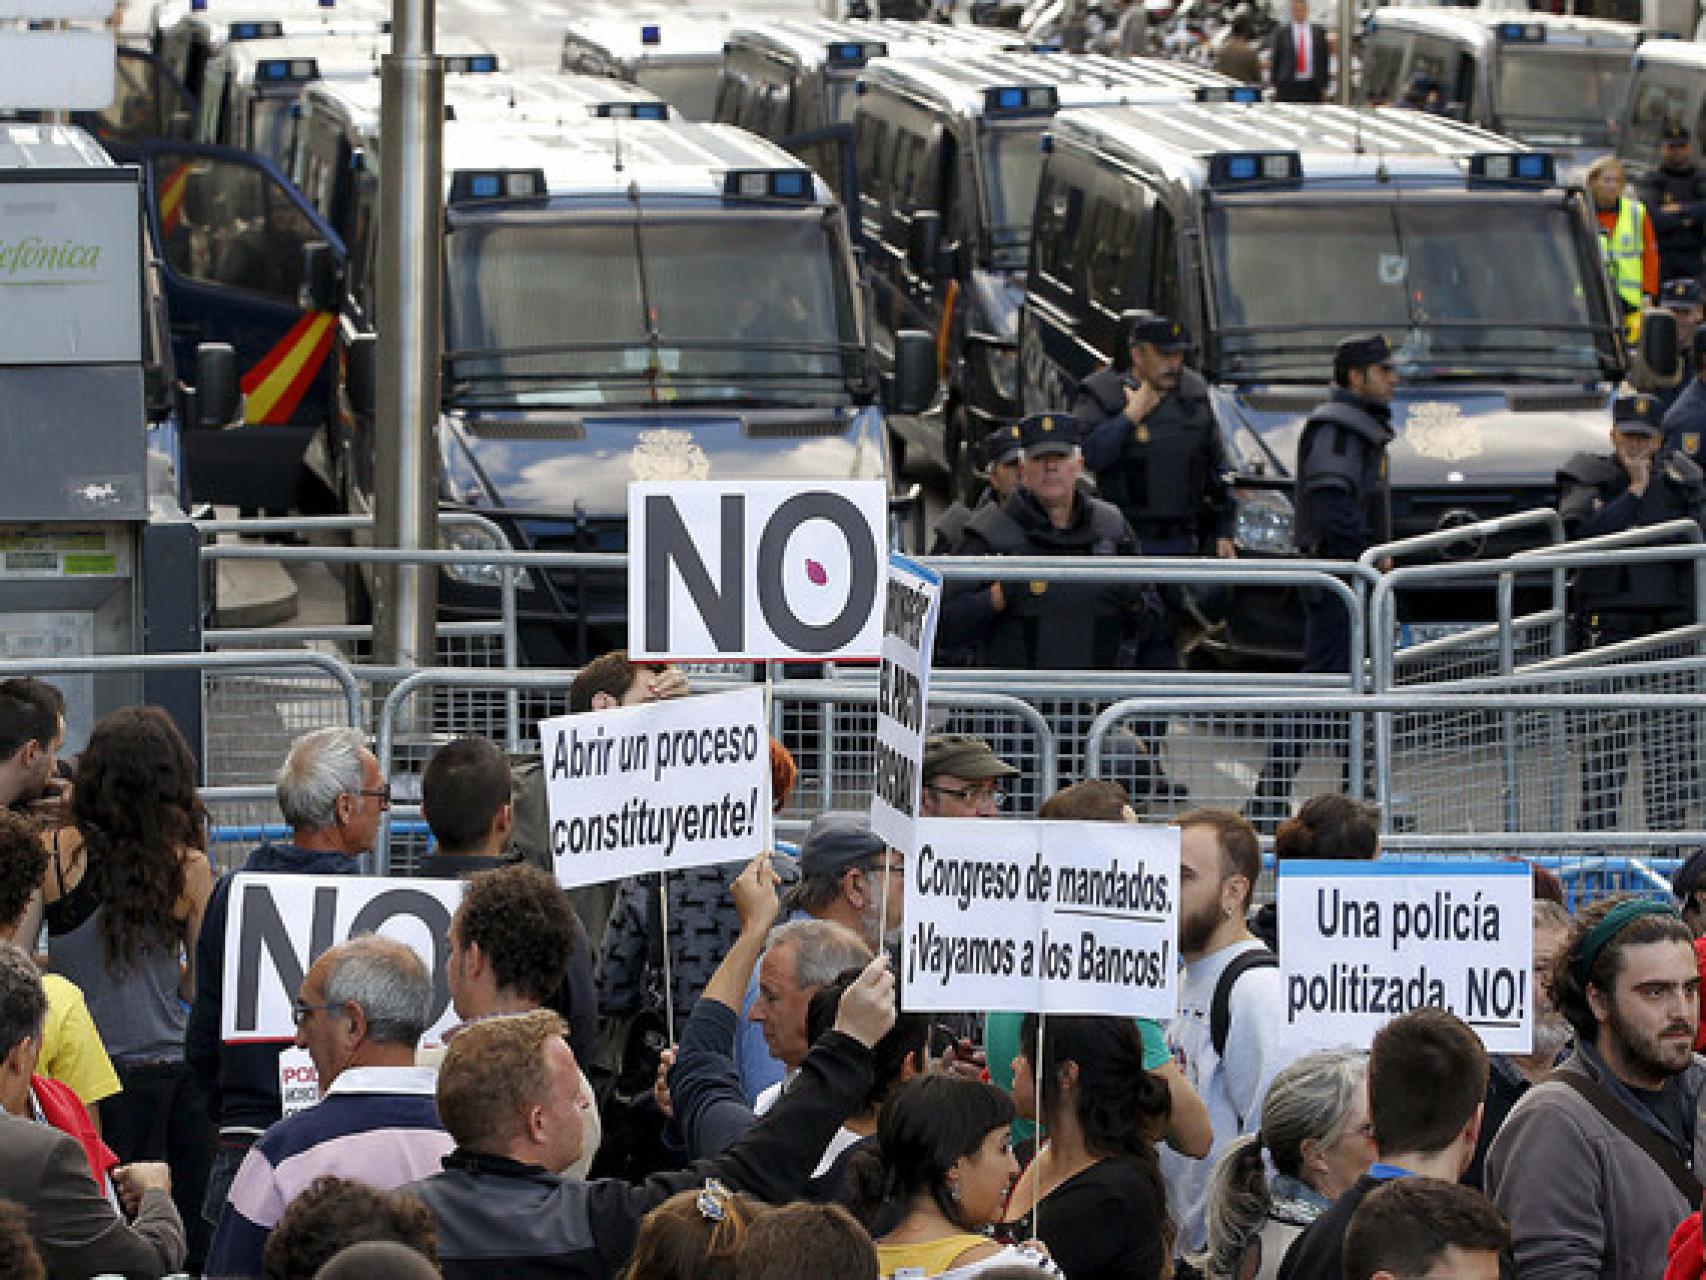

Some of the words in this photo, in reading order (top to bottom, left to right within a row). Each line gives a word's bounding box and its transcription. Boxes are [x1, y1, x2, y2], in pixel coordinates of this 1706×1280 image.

[644, 490, 878, 654] NO
[551, 726, 615, 781] Abrir
[619, 732, 650, 772] un
[654, 723, 758, 782] proceso
[551, 786, 758, 857] constituyente!
[918, 843, 1020, 910] Congreso
[1026, 852, 1051, 902] de
[1317, 888, 1380, 938] Una
[1393, 889, 1500, 952] policía
[235, 883, 453, 1031] NO
[907, 921, 1016, 986] ¡Vayamos
[1020, 939, 1034, 977] a
[1039, 928, 1073, 980] los
[1078, 930, 1169, 988] Bancos!
[1466, 966, 1527, 1020] NO!
